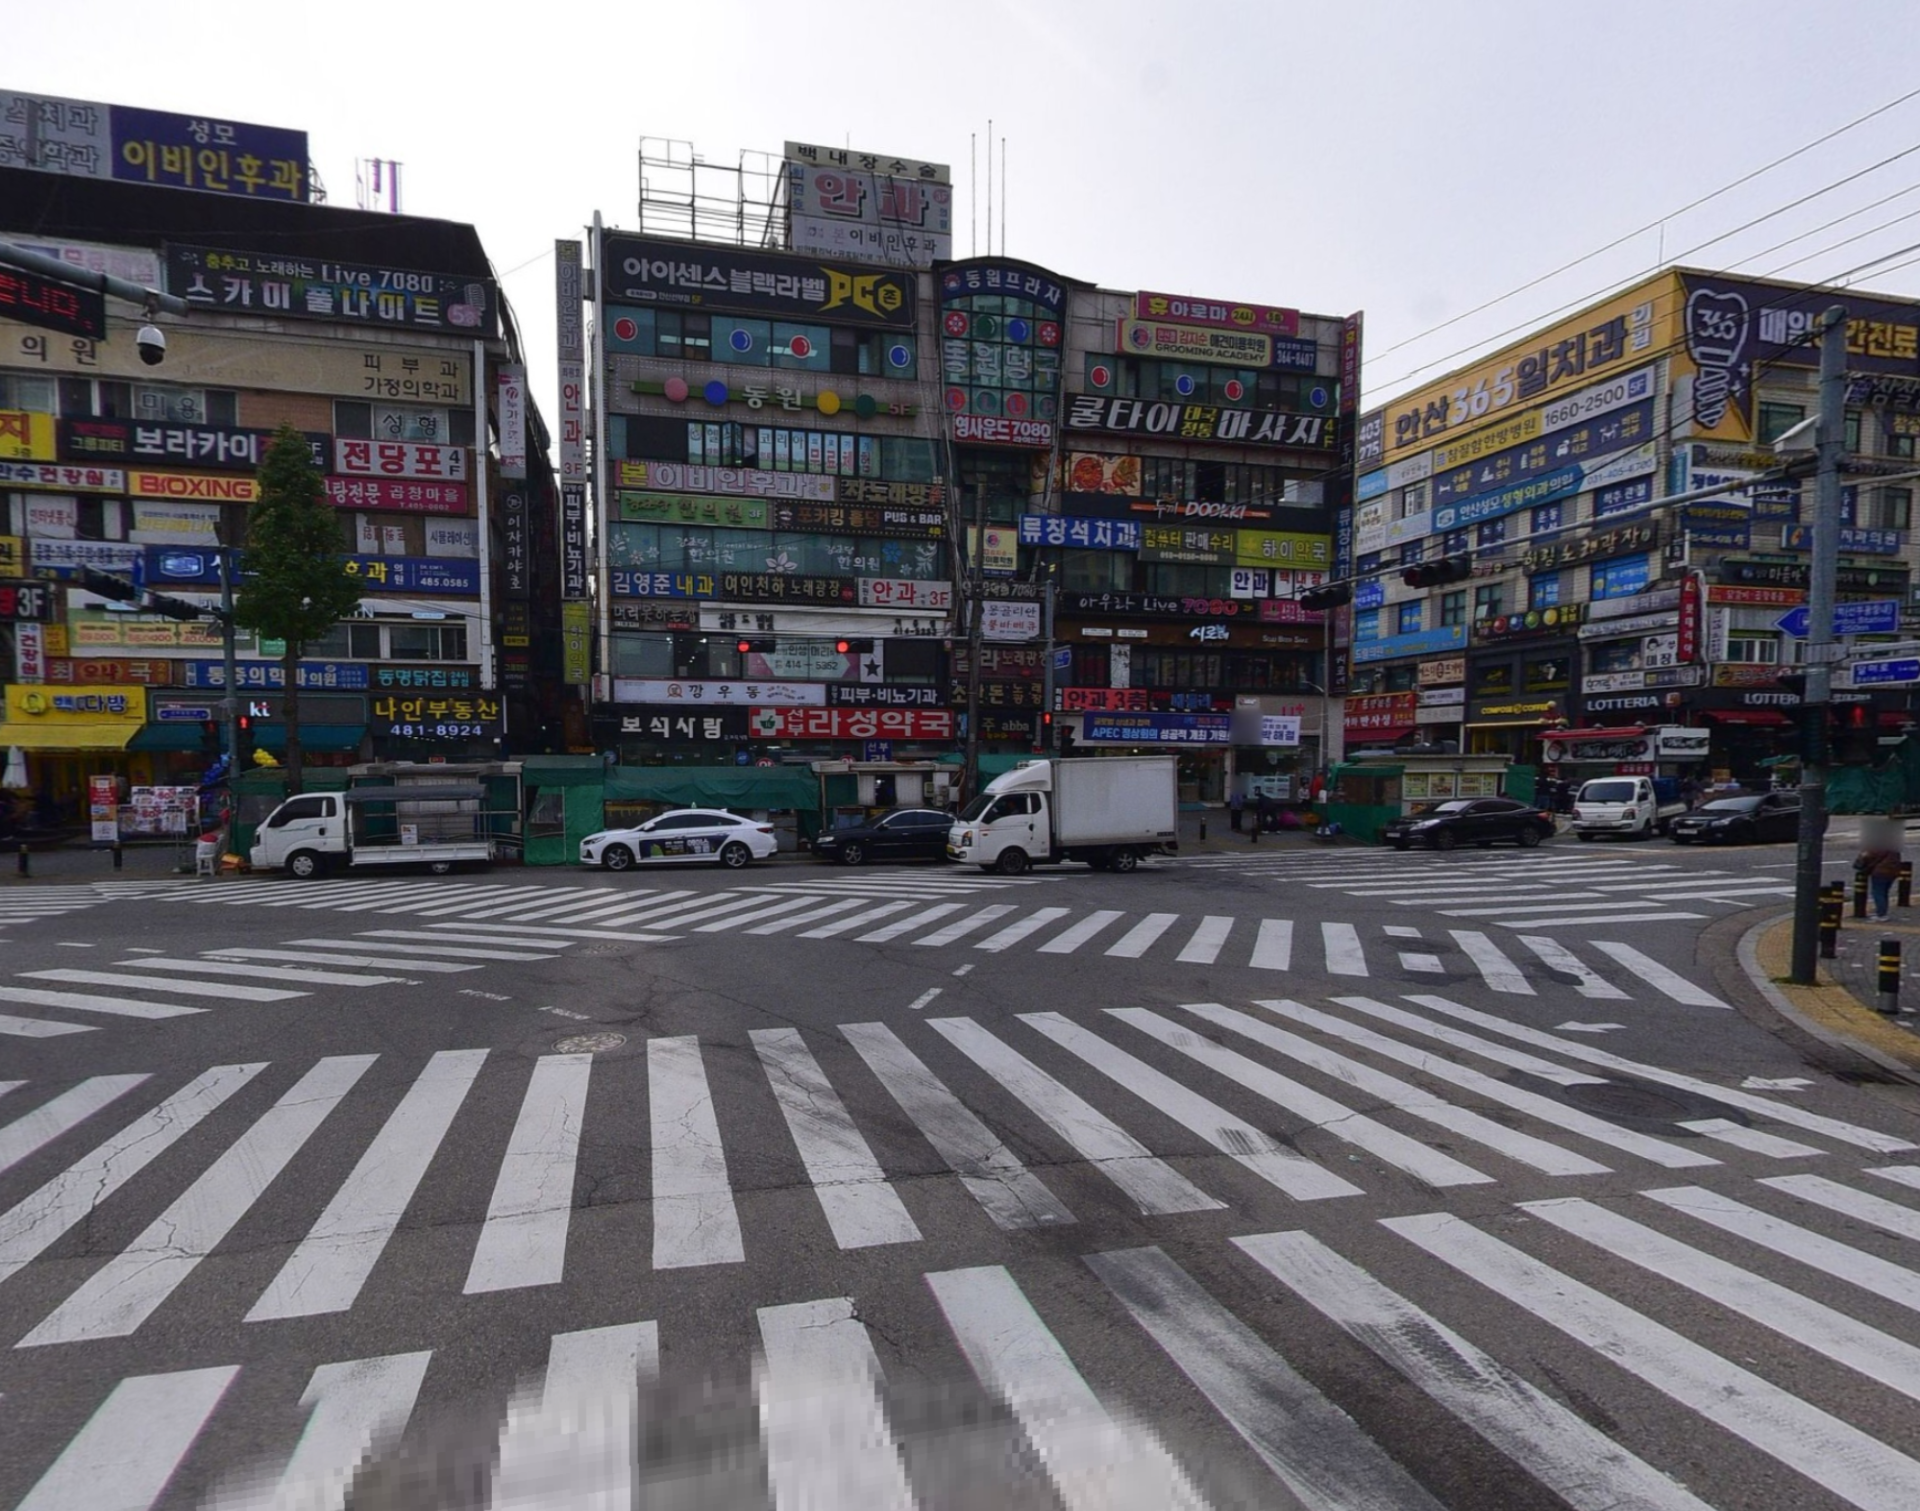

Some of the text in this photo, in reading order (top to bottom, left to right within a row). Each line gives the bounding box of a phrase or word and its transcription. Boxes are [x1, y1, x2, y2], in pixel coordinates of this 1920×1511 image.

[188, 120, 236, 146] 성모
[123, 139, 302, 200] 이비인후과
[798, 145, 937, 179] 백내장수술
[815, 172, 929, 227] 안과
[849, 228, 937, 255] 이비인후과
[256, 258, 315, 281] 노래하는
[322, 264, 371, 288] Live
[379, 270, 434, 295] 7080
[623, 257, 825, 302] 아이센스블랙라벨
[965, 268, 1061, 306] 동원프라자
[1171, 301, 1227, 321] 아로마
[20, 333, 97, 368] 의원
[1155, 343, 1266, 363] GROOMING ACADEMY
[364, 353, 460, 383] 피부과
[364, 377, 460, 402] 가정의학과
[742, 384, 803, 412] 동원
[563, 383, 582, 447] 안과
[1544, 384, 1625, 427] 1660-2500
[1629, 379, 1646, 394] 5F
[383, 413, 438, 437] 성형
[1011, 420, 1051, 437] 7080
[1069, 396, 1181, 432] 쿨타이
[1216, 410, 1322, 445] 마사지
[133, 427, 257, 463] 보라카이
[1359, 442, 1380, 464] 275
[343, 441, 443, 476] 전당포
[564, 462, 584, 475] 3F
[620, 461, 807, 498] 본 이비인후과
[389, 486, 460, 502] 곱창마을
[749, 509, 763, 518] 3F
[884, 511, 909, 524] PUB
[910, 516, 917, 524] &
[919, 513, 942, 525] BAR
[1023, 516, 1137, 547] 류창석치과
[1144, 528, 1182, 549] 컴퓨터
[1262, 539, 1325, 562] 하이약국
[420, 577, 469, 588] 485.0585
[612, 571, 714, 595] 김영준 내과
[724, 574, 841, 598] 여인천하 노래광장
[873, 580, 949, 606] 안과 3F
[1233, 571, 1269, 592] 안과
[17, 587, 44, 617] 3F
[1143, 598, 1178, 611] Live
[1181, 598, 1239, 616] 7080
[785, 659, 802, 669] 414
[688, 684, 761, 699] 깡우동
[1067, 690, 1108, 710] 안과
[1586, 696, 1660, 711] LOTTERIA
[250, 702, 271, 718] kt
[374, 698, 499, 721] 나인부동산
[390, 724, 482, 736] 481-8924
[621, 716, 723, 740] 보석사람
[809, 709, 951, 737] 라성약국
[1092, 727, 1120, 738] APEC
[1121, 728, 1158, 739] 정상회의
